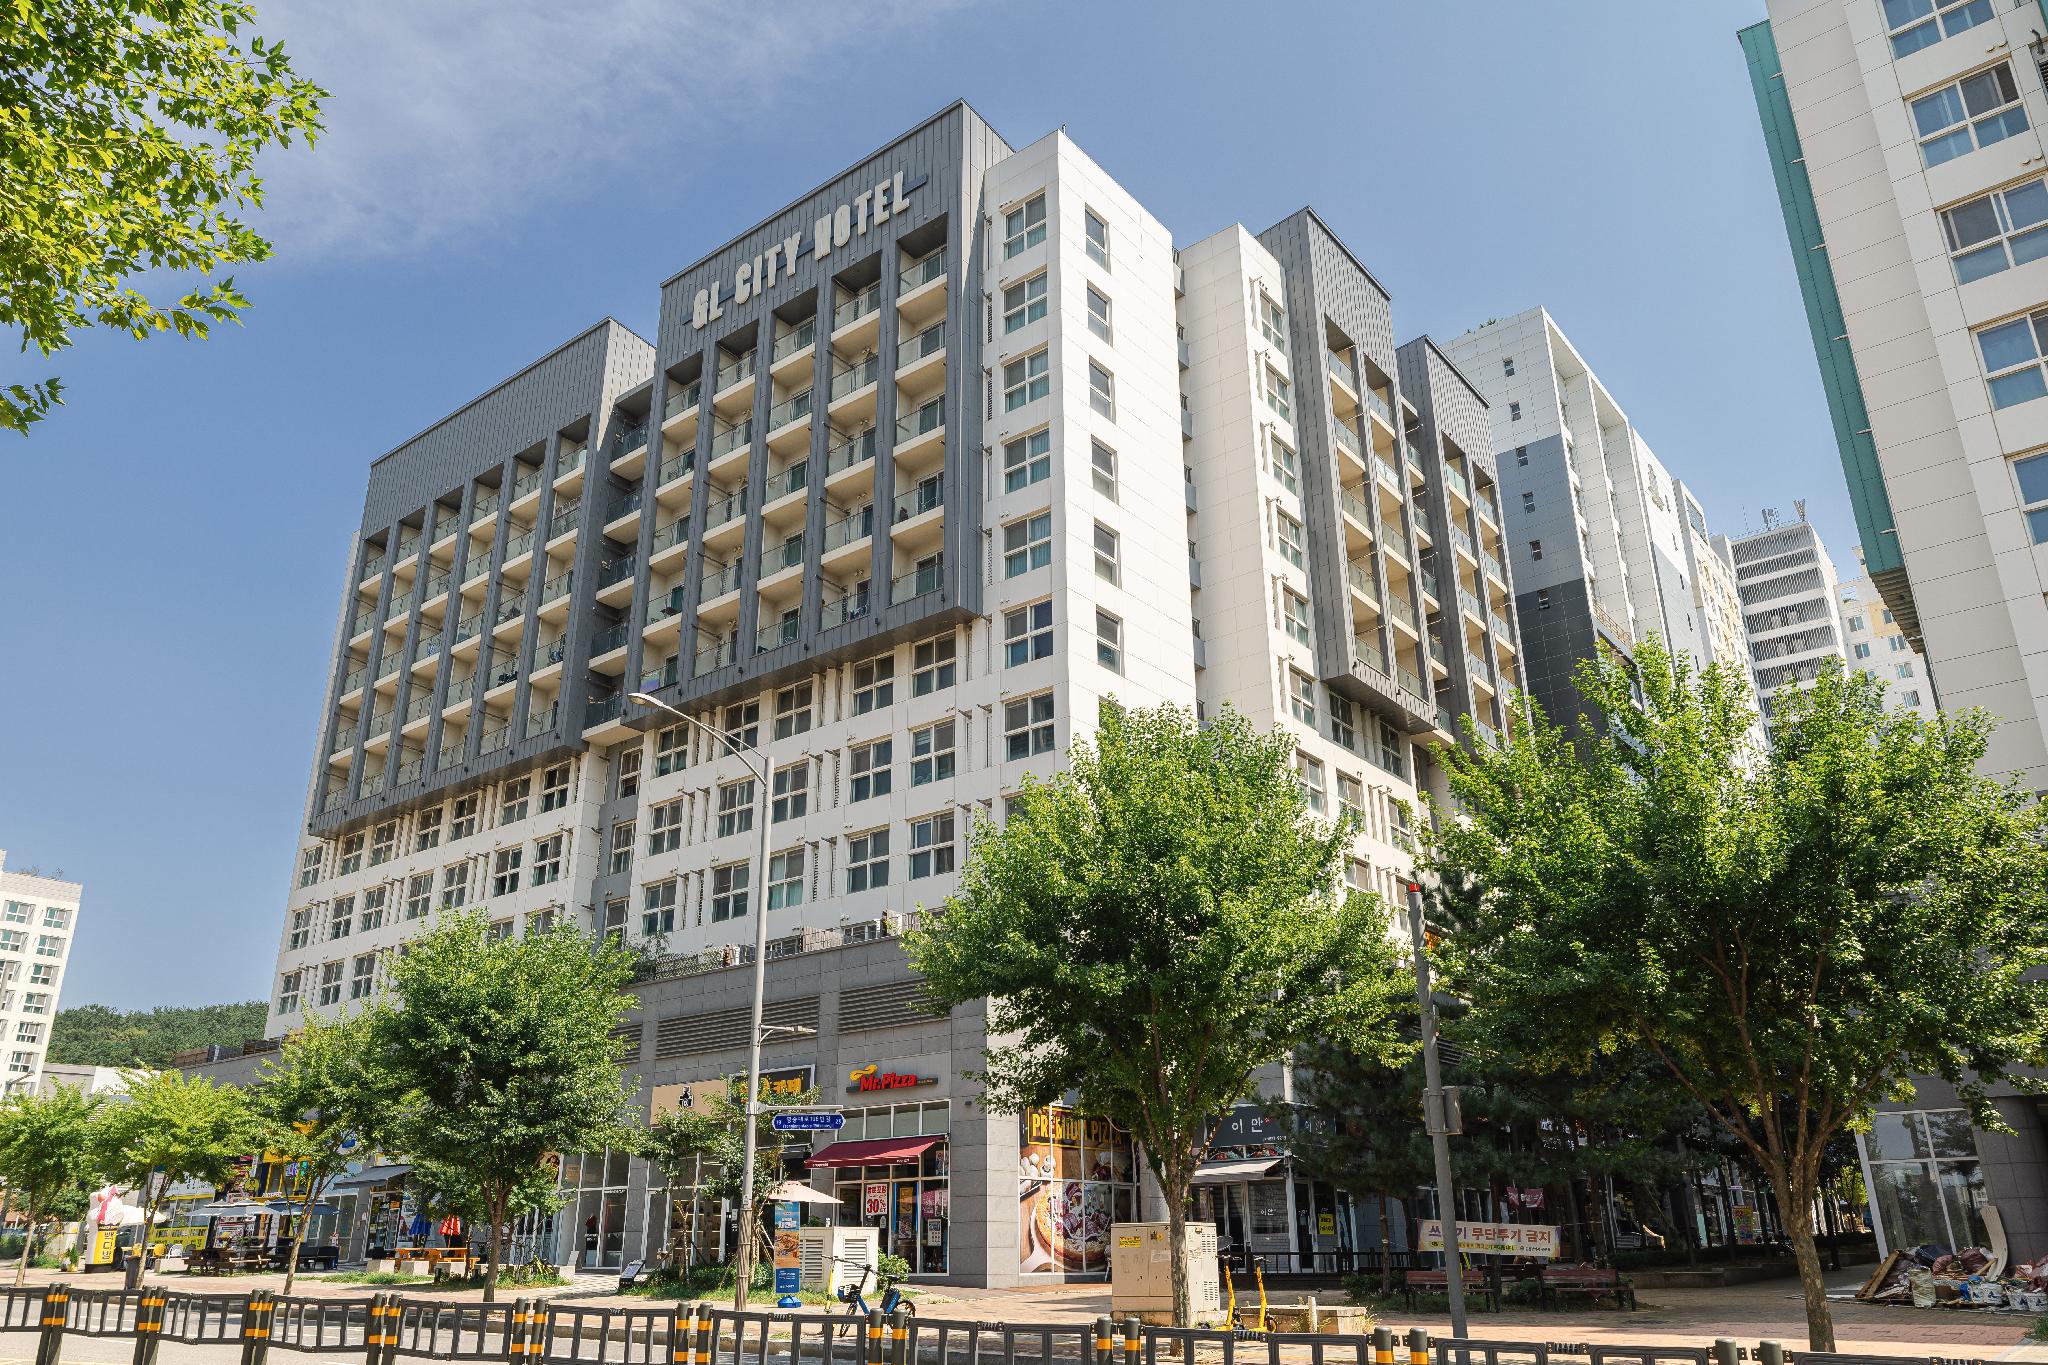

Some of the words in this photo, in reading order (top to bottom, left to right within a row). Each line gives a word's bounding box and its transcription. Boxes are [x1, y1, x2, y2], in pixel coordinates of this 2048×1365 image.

[692, 281, 724, 330] GL
[734, 231, 802, 305] CITY
[814, 170, 910, 261] HOTEL
[1428, 1225, 1467, 1240] 쓰기
[1472, 1227, 1522, 1243] 무단투기
[1525, 1229, 1551, 1244] 금지
